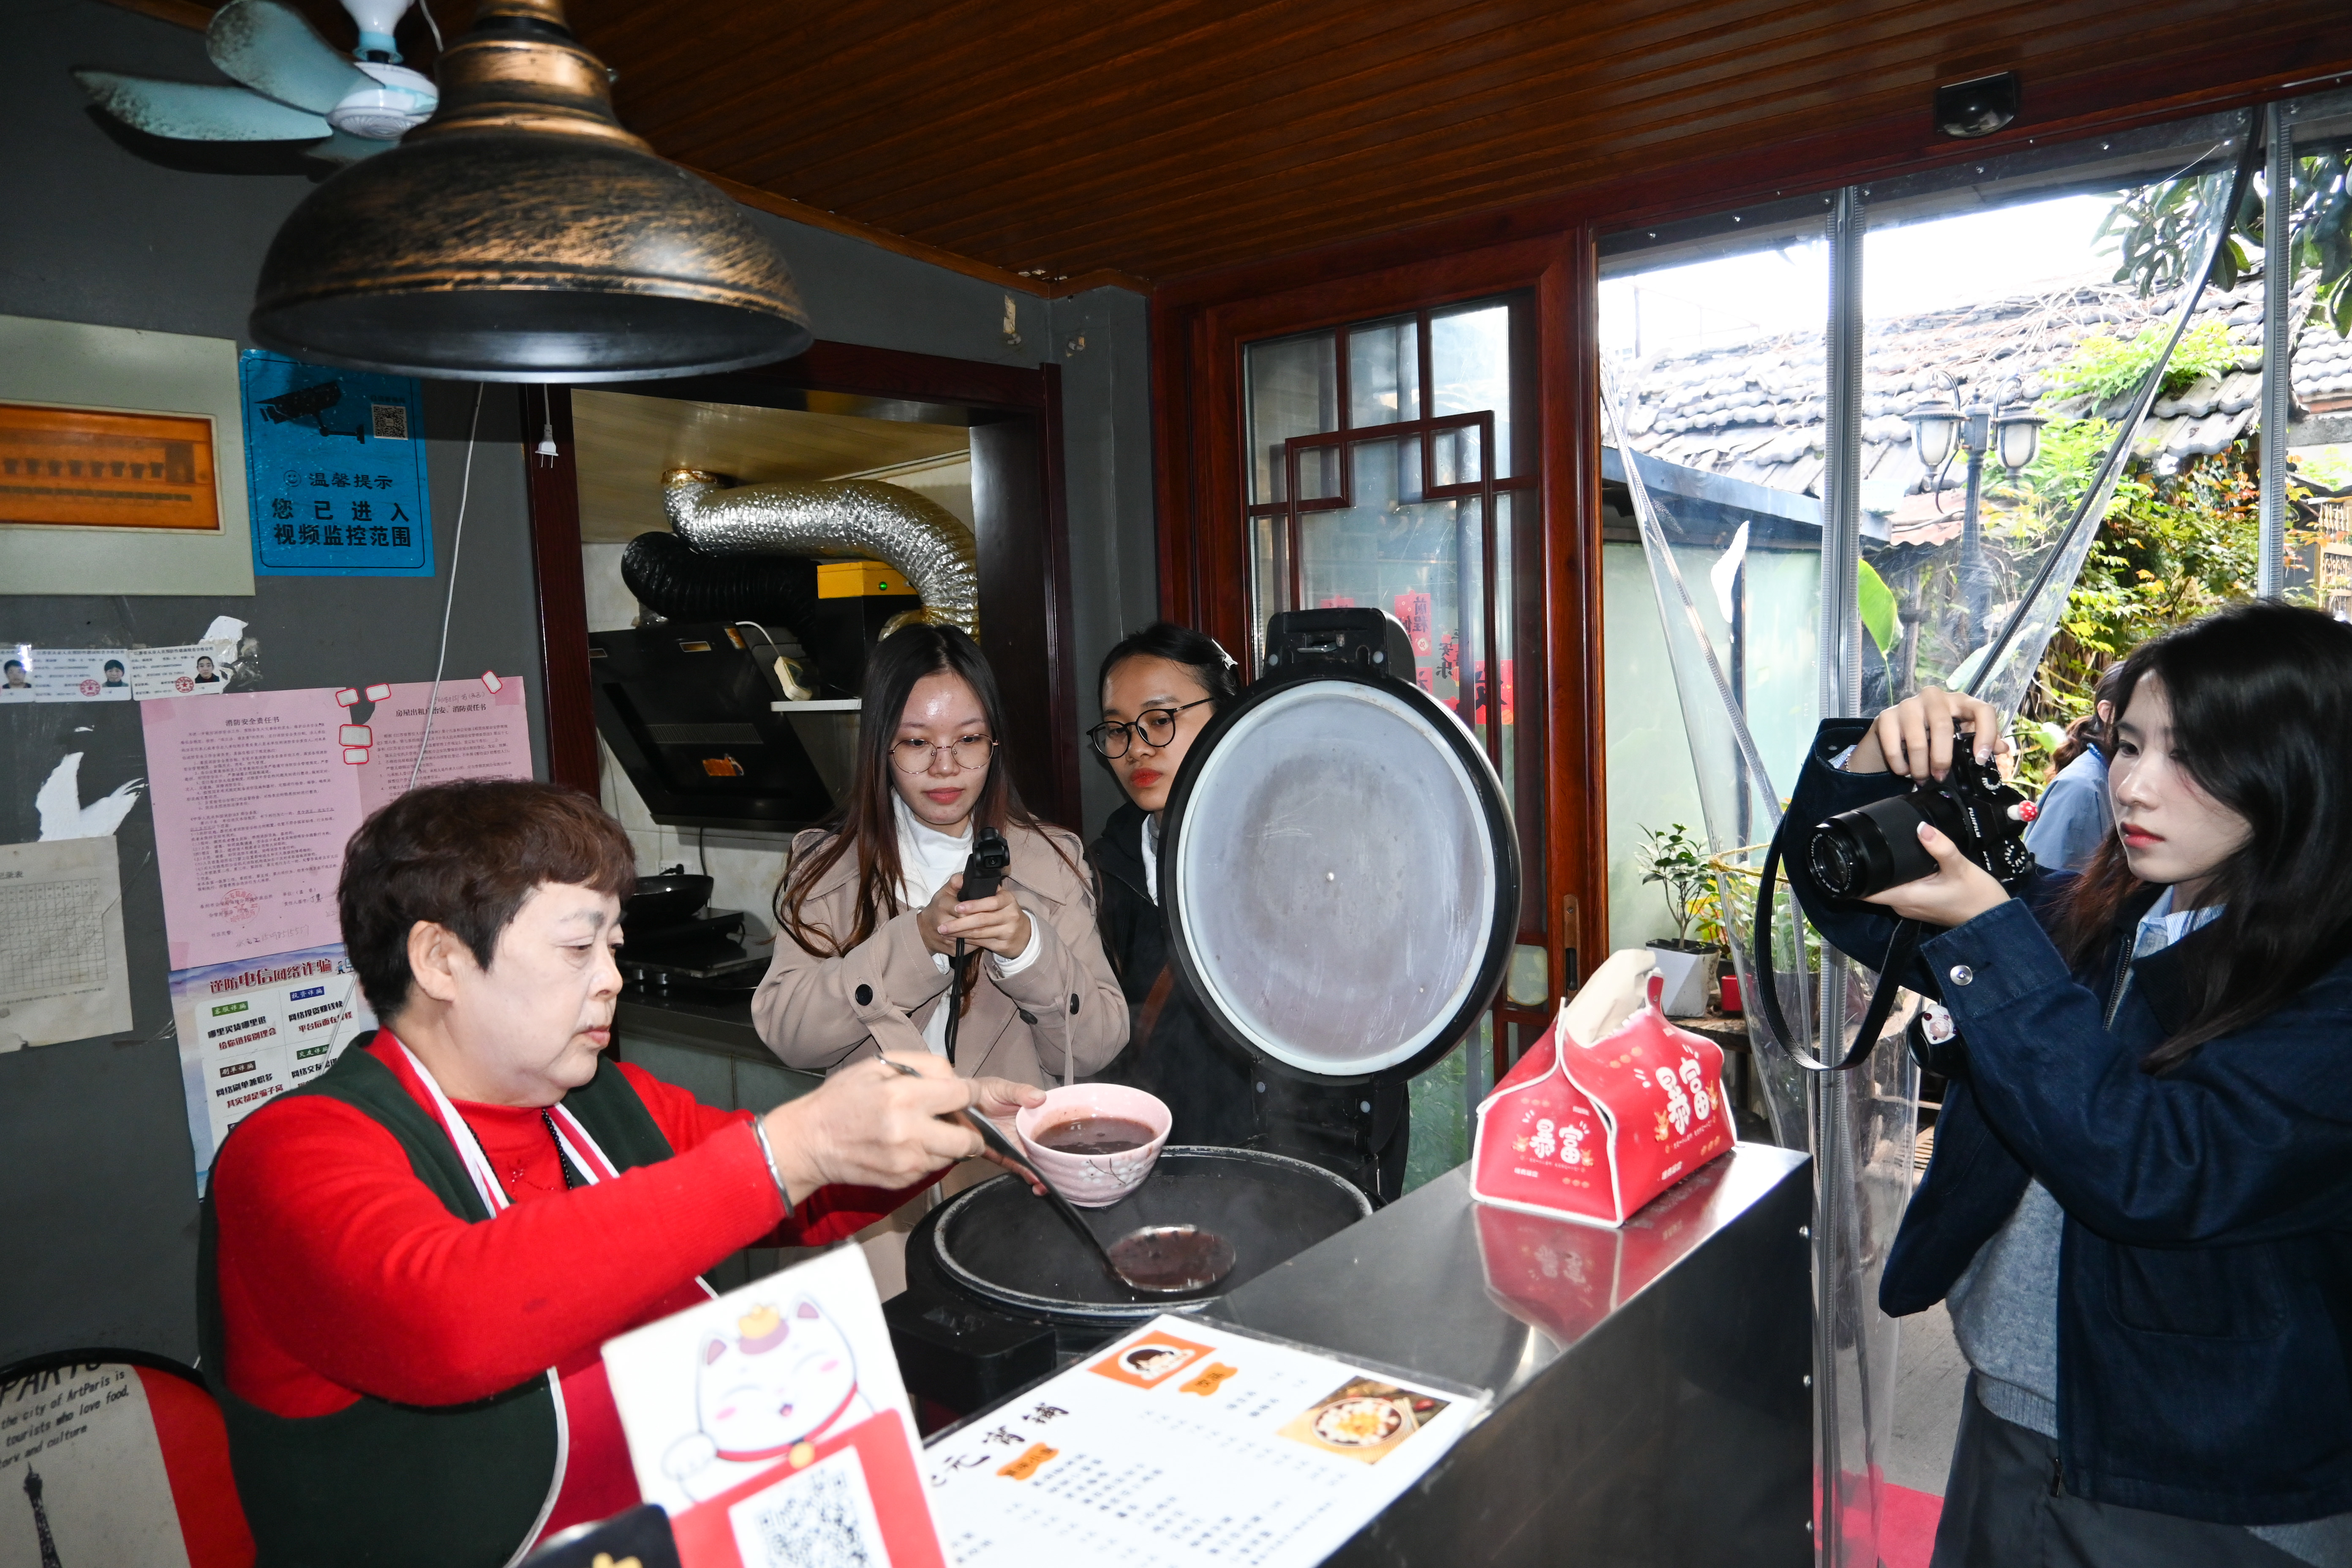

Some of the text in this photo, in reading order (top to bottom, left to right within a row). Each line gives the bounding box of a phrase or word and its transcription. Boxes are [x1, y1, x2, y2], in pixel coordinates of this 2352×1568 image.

[309, 472, 393, 489] 温馨提示
[272, 498, 409, 522] 您已进入
[274, 523, 411, 547] 视频监控范围
[225, 716, 280, 727] 消防安全责任书
[1968, 807, 1982, 838] FUJIFILM
[210, 958, 332, 994] 谨防电信网络诈骗
[291, 988, 323, 999] 投资诈骗
[289, 1000, 343, 1021] 网络投资赚钱快
[207, 1015, 267, 1038] 哪里买货哪里退
[219, 1027, 277, 1051] 给你链接别理会
[299, 1045, 328, 1058] 交友诈骗
[222, 1062, 254, 1075] 刷单诈骗
[215, 1073, 273, 1097] 网络刷单兼职多
[1655, 1056, 1710, 1135] 暴富
[1529, 1118, 1584, 1164] 暴富
[2, 1371, 125, 1429] the city of ArtParis is
[6, 1420, 51, 1447] tourists
[56, 1412, 74, 1425] who
[79, 1399, 101, 1416] love
[24, 1441, 44, 1458] and
[47, 1424, 87, 1448] culture
